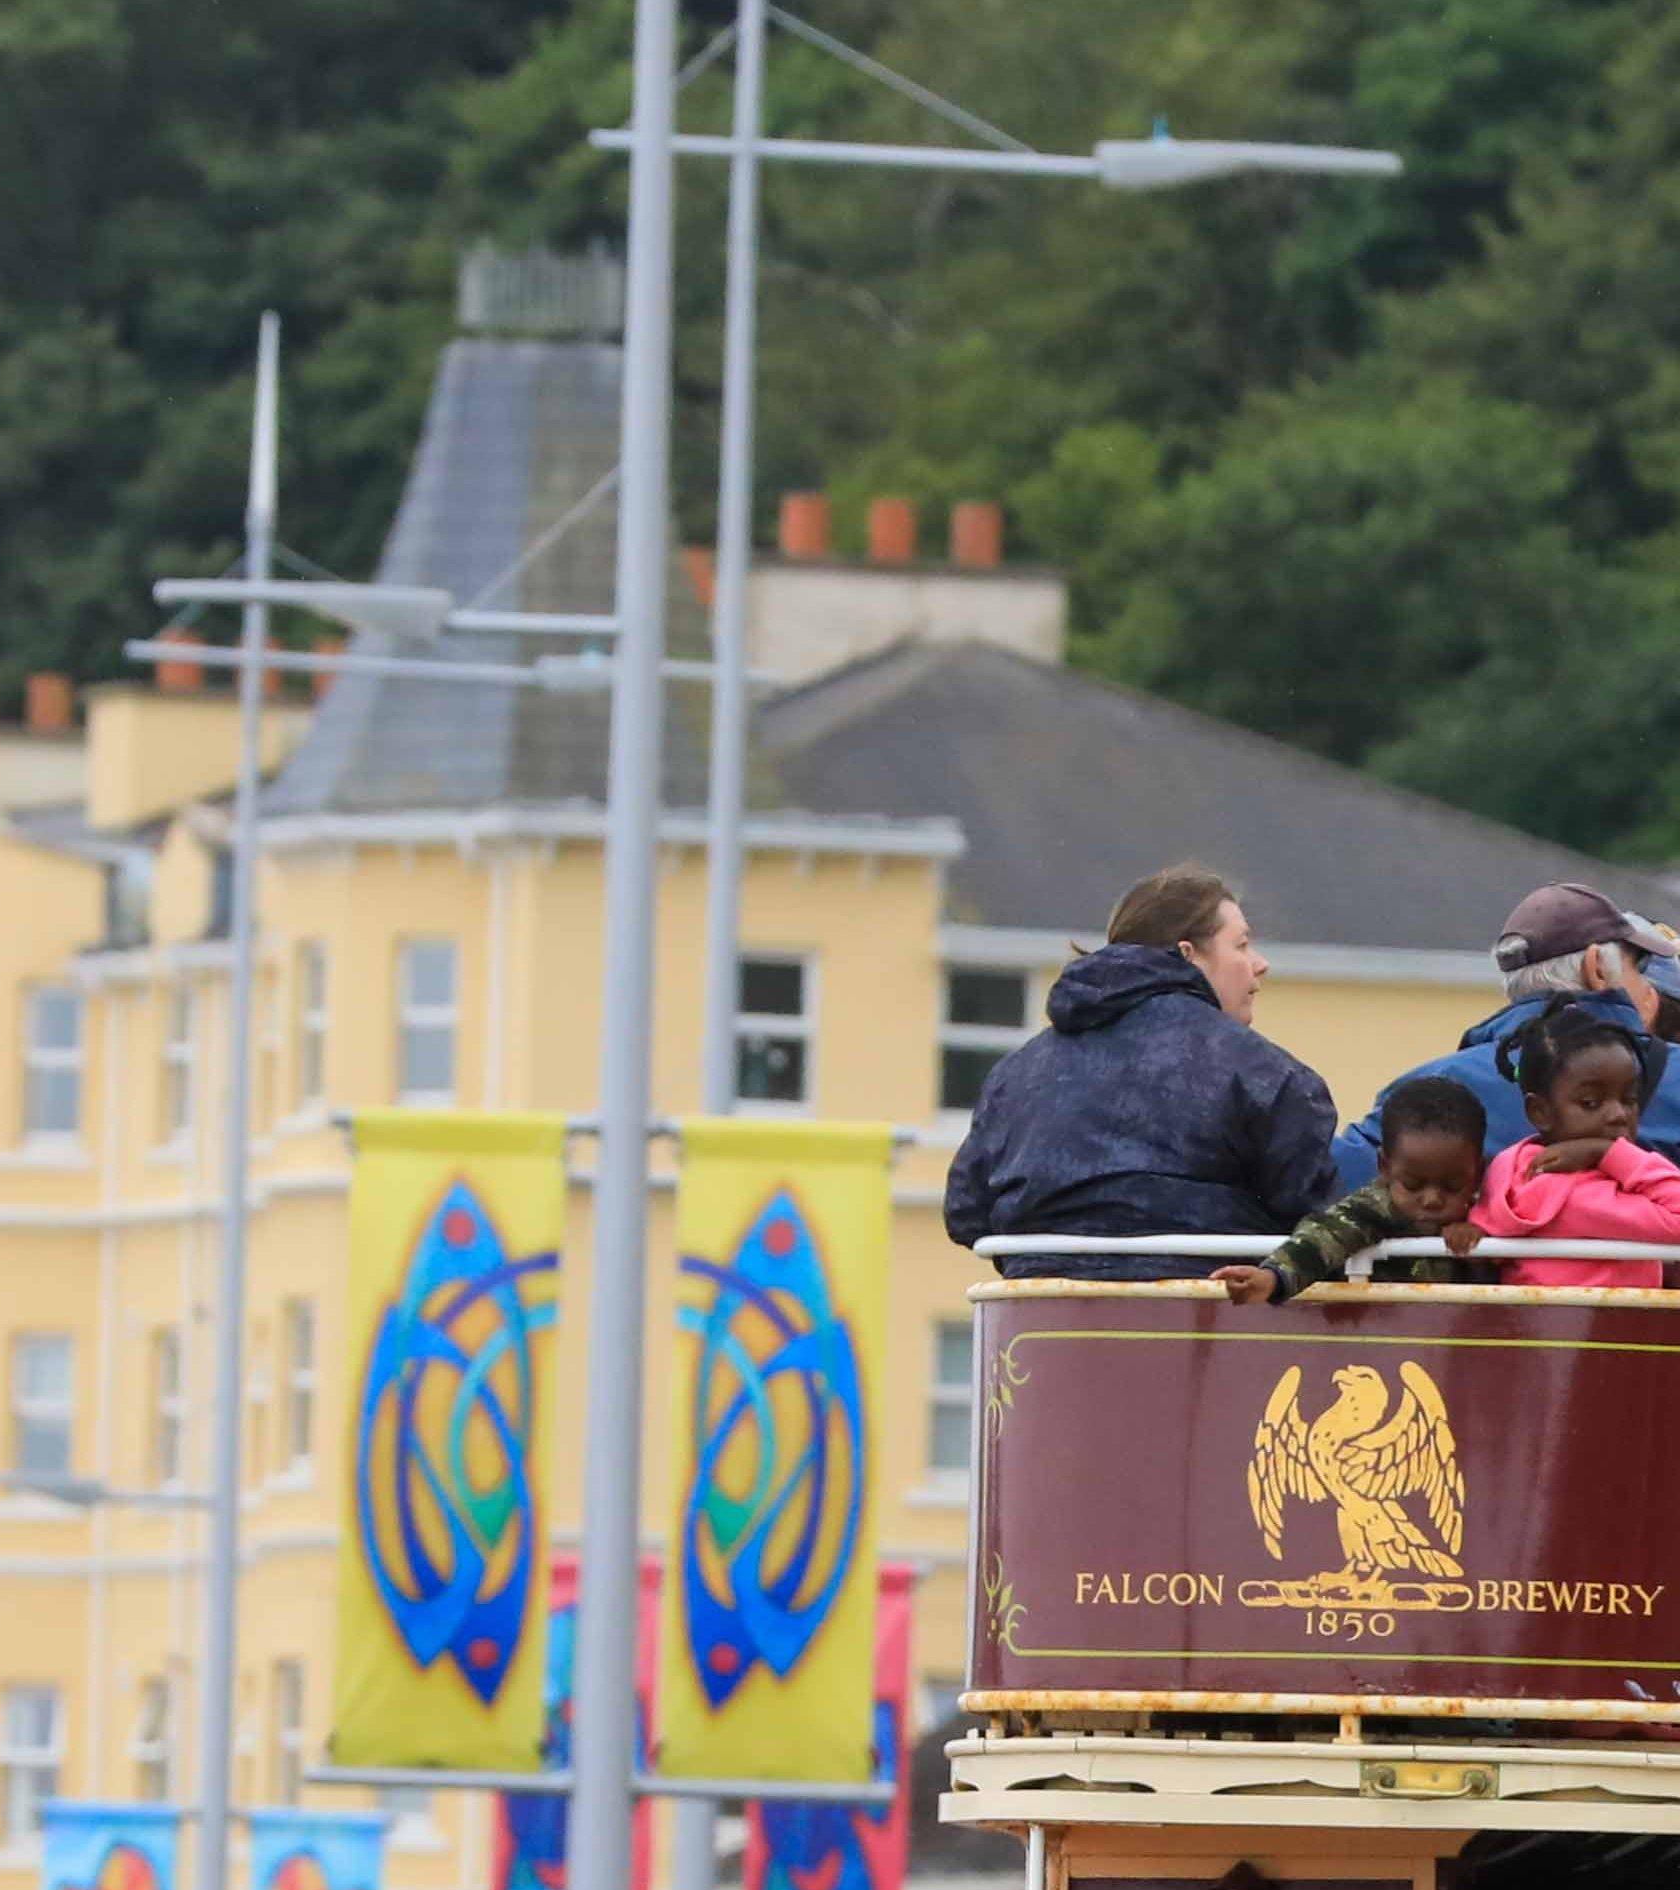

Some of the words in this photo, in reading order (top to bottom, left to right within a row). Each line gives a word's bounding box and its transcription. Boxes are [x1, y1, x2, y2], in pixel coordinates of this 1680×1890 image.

[1075, 1571, 1224, 1606] FALCON
[1476, 1579, 1665, 1617] BREWERY
[1304, 1610, 1397, 1642] 1850
